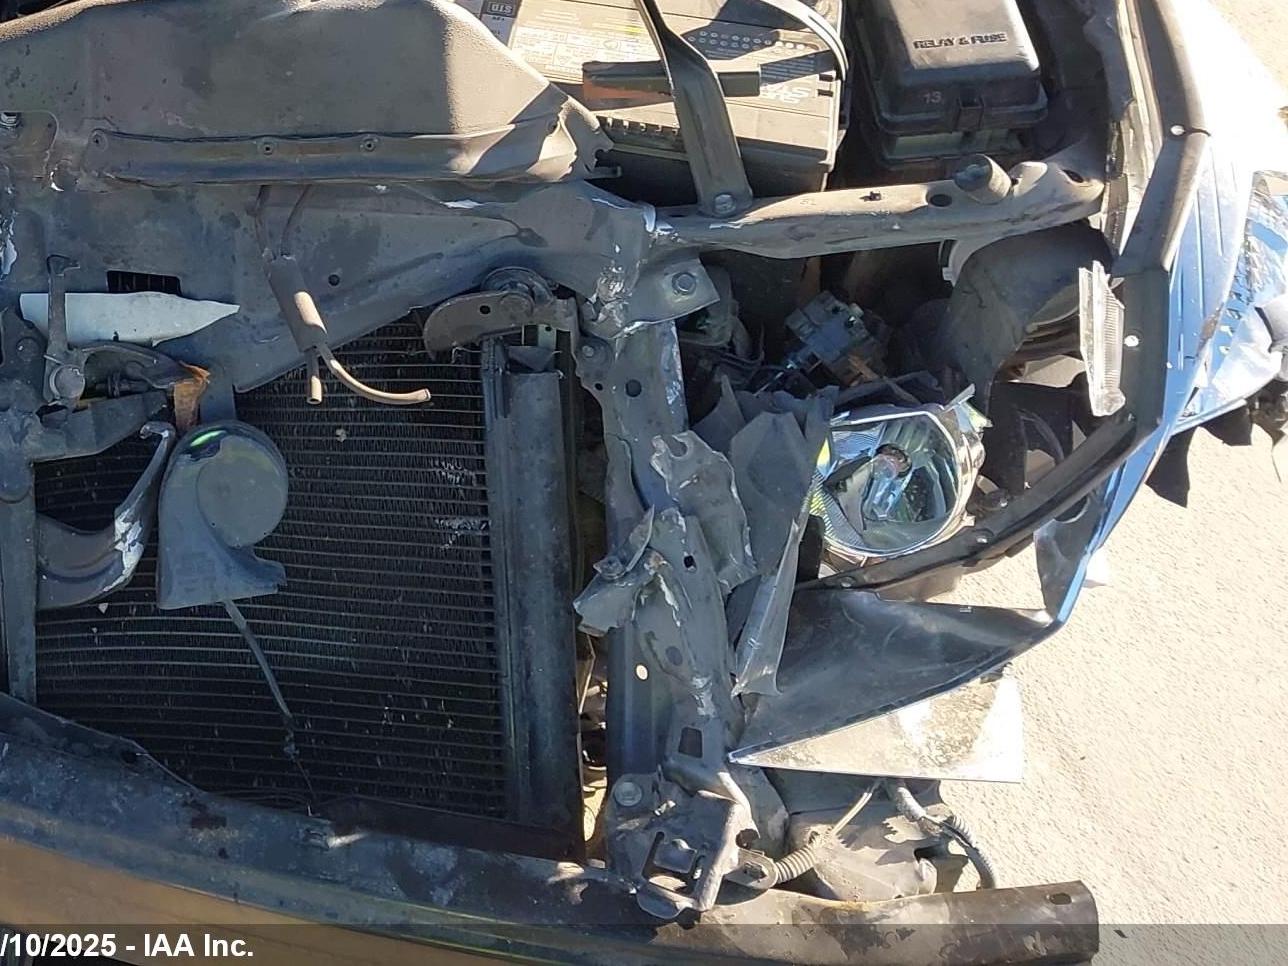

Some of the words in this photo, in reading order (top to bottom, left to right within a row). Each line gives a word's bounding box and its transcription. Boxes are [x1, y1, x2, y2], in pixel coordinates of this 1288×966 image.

[913, 37, 955, 49] RELAY
[958, 35, 969, 46] &
[970, 32, 1008, 44] FUSE
